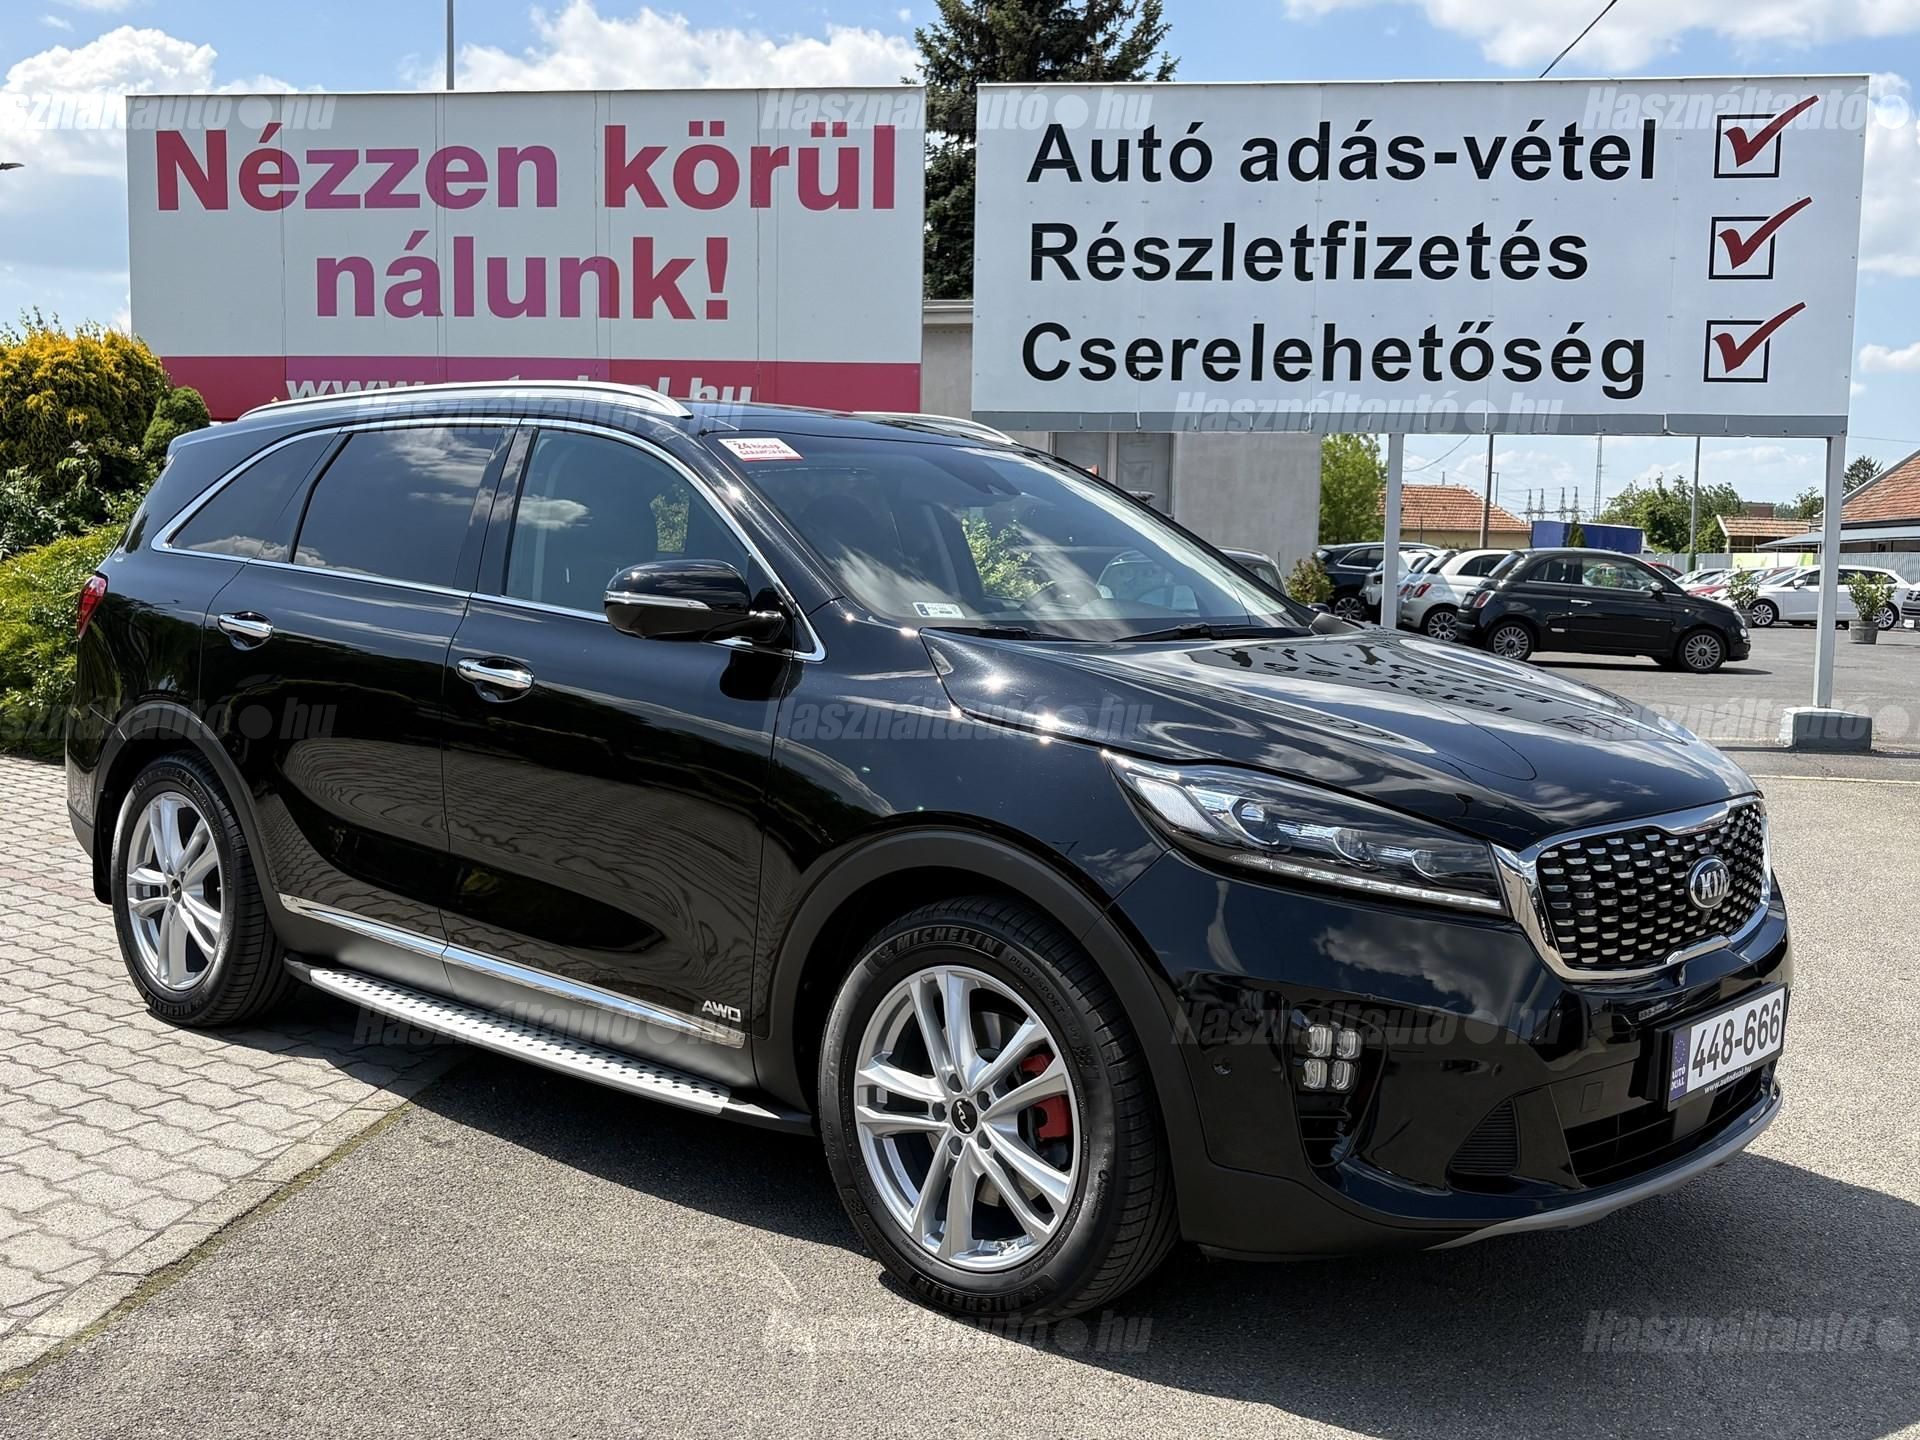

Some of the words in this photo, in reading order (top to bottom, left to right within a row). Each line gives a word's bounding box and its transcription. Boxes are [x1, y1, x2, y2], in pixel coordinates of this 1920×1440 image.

[156, 123, 557, 211] Nézzen
[604, 121, 895, 210] körül
[1026, 121, 1213, 183] Autó
[1240, 119, 1656, 183] adás-vétel
[317, 231, 728, 320] nálunk!
[1030, 218, 1588, 283] Részletfizetés
[1022, 321, 1644, 400] Cserelehetőség
[896, 926, 1002, 954] MICHELIN
[702, 1000, 741, 1022] AWD
[1692, 998, 1781, 1078] 448-666
